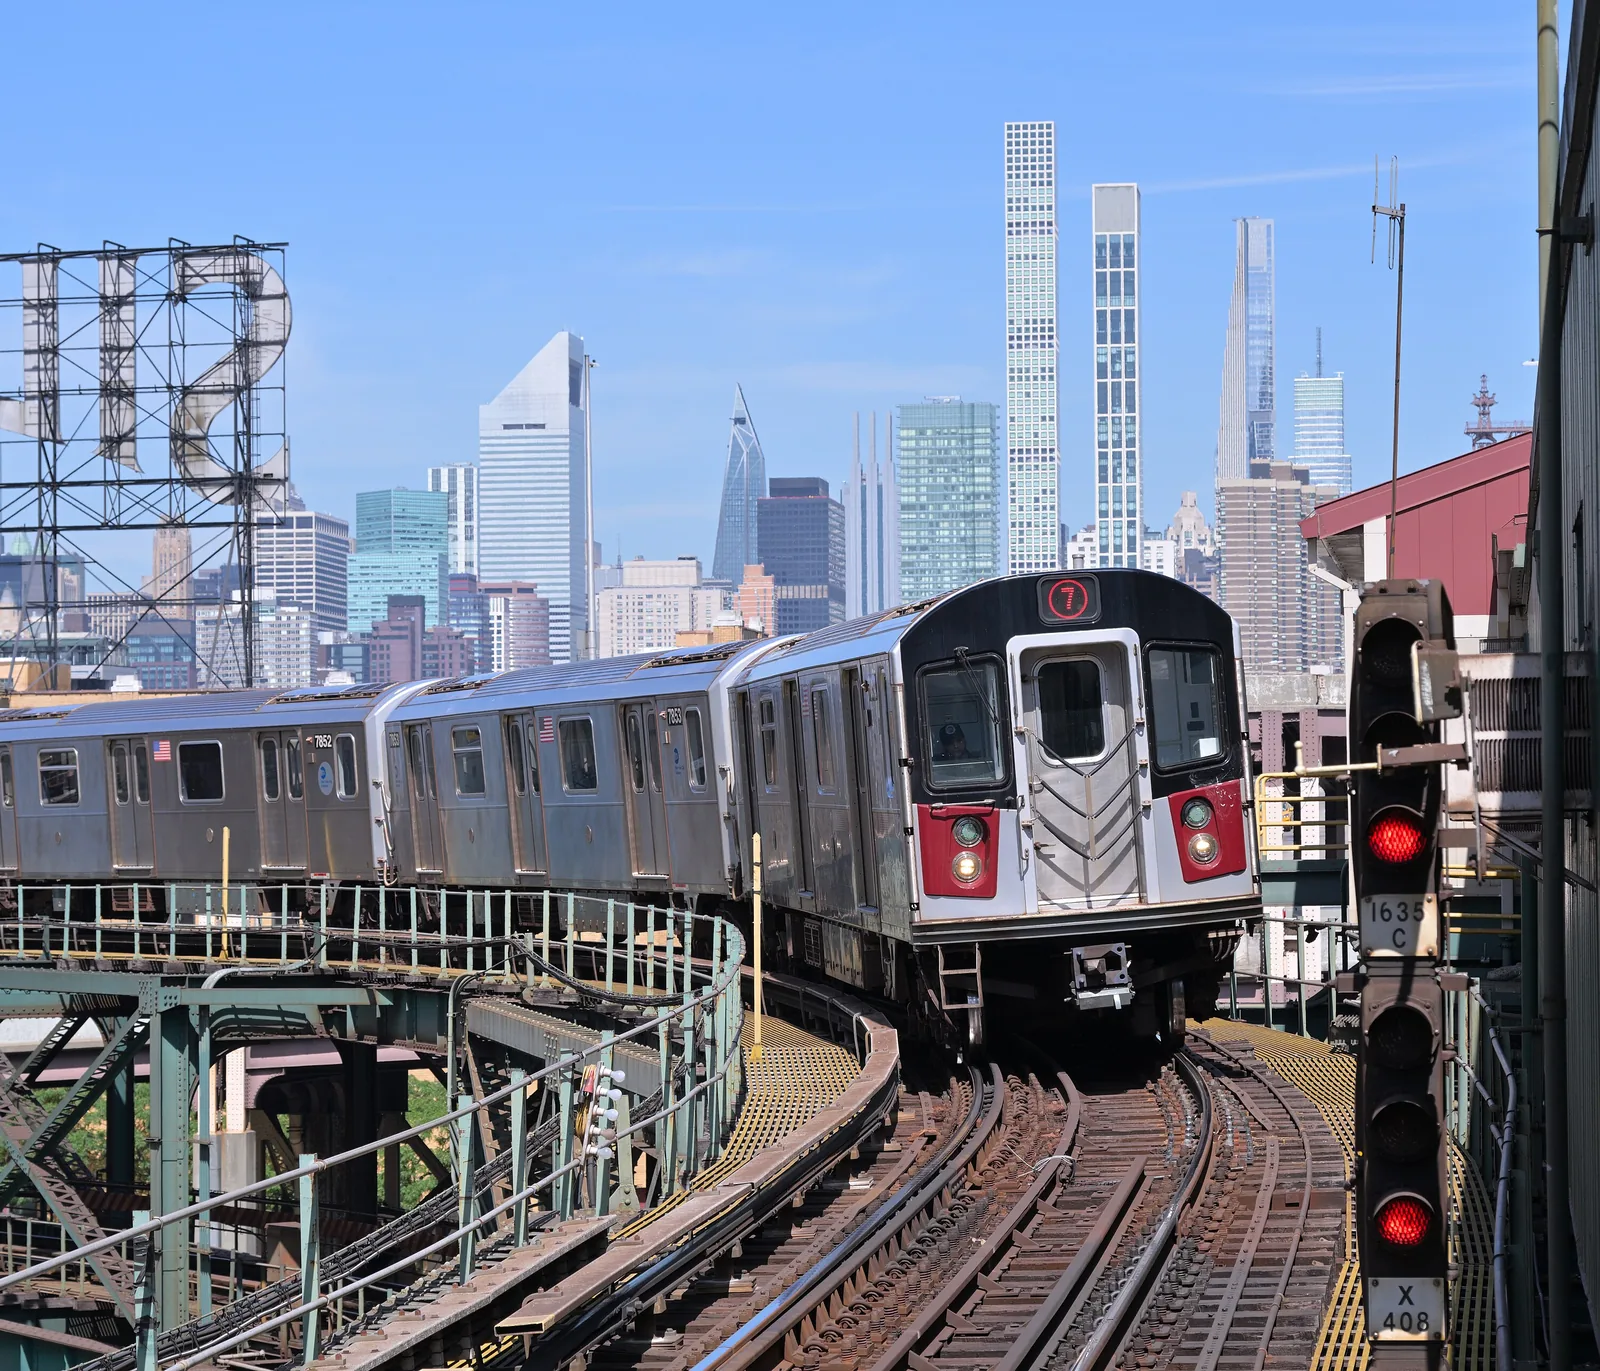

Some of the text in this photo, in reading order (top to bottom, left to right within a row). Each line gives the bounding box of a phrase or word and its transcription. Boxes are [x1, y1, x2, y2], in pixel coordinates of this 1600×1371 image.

[1061, 587, 1075, 610] 7
[667, 708, 682, 724] 7853
[314, 734, 333, 748] 7852
[1372, 902, 1425, 922] 1635
[1392, 927, 1406, 949] C
[1398, 1285, 1415, 1306] X
[1383, 1311, 1430, 1332] 408
